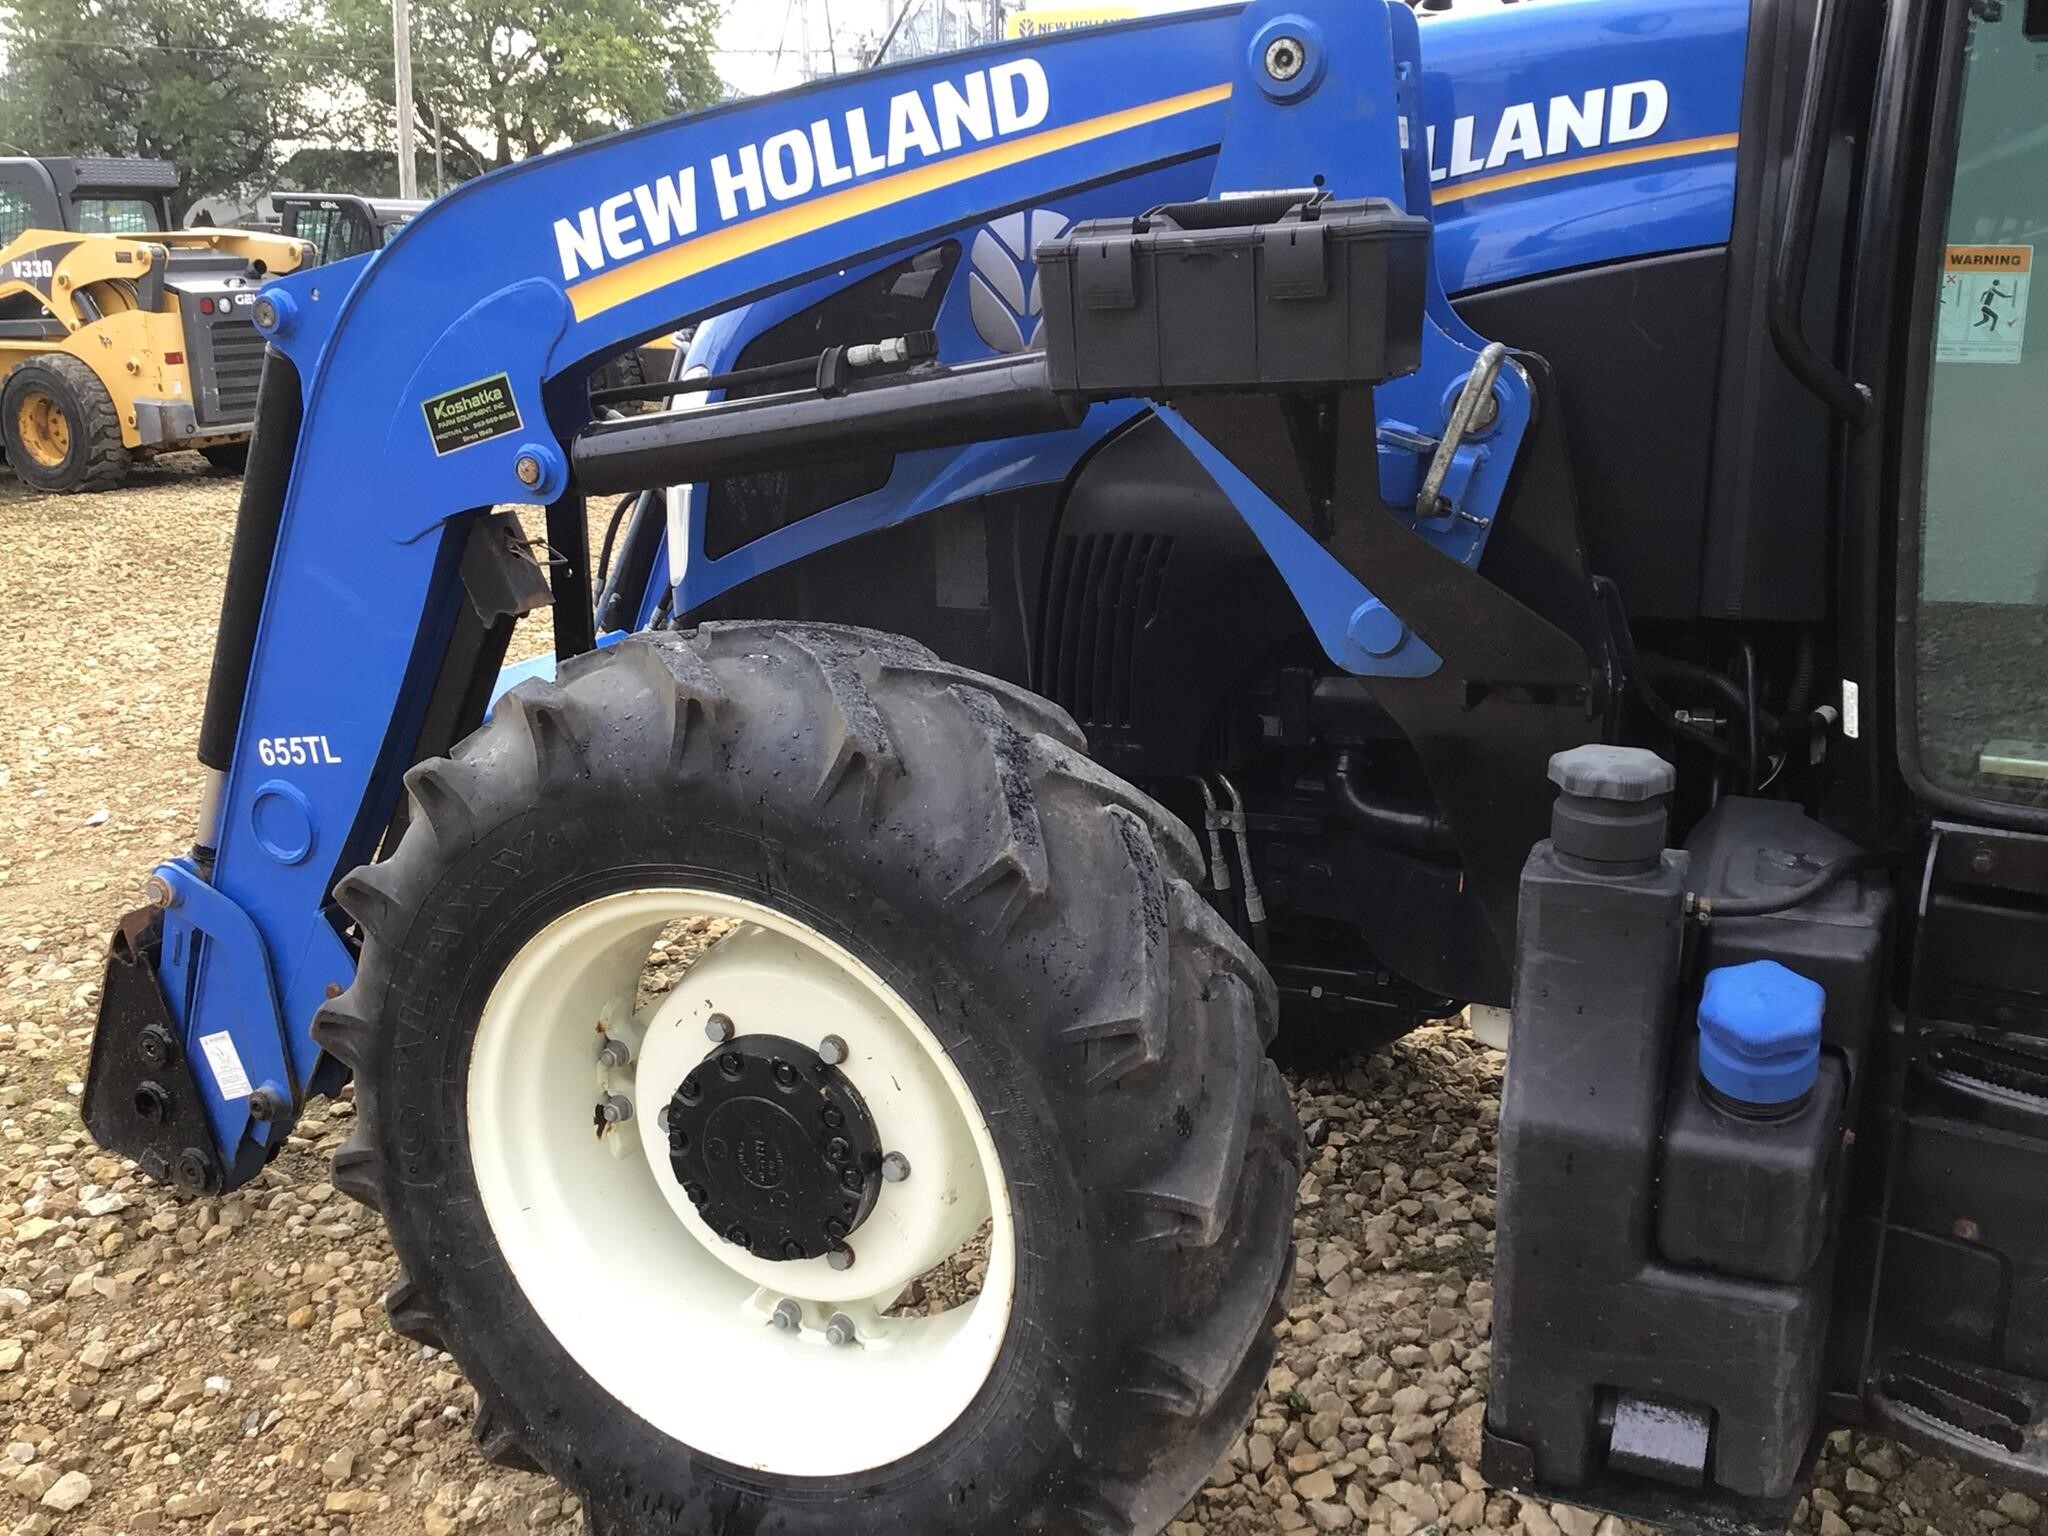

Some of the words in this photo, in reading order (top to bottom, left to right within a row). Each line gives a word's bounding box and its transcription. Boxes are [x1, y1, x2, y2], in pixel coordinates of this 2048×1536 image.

[553, 166, 698, 281] NEW
[711, 57, 1050, 221] HOLLAND
[11, 259, 53, 278] V330
[1950, 254, 2022, 266] WARNING
[234, 293, 258, 306] GE
[433, 388, 503, 420] Koshatka
[437, 417, 456, 430] FARM
[258, 735, 343, 767] 655TL
